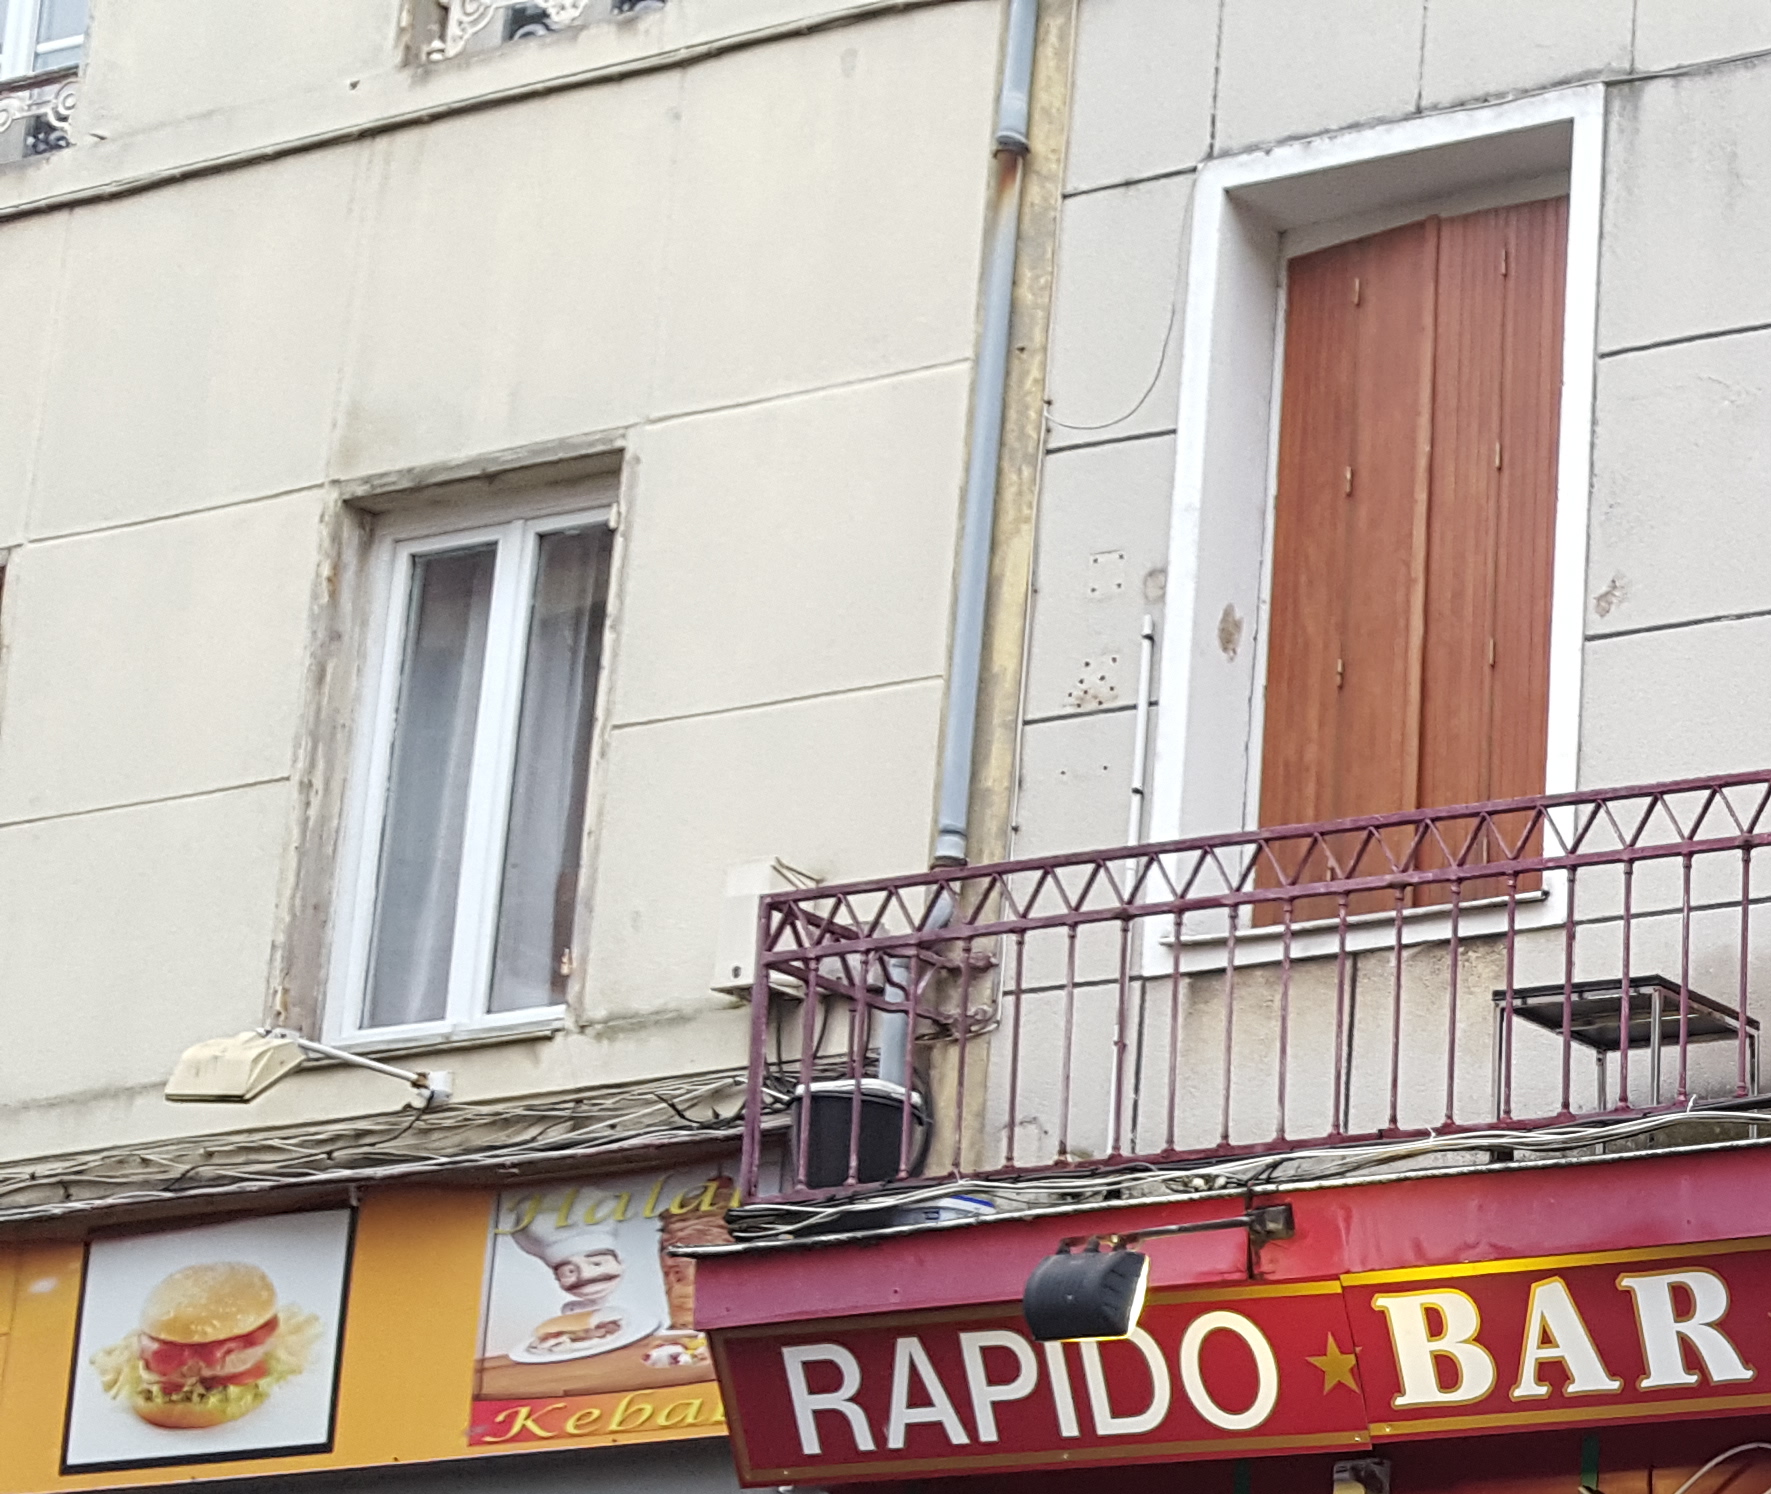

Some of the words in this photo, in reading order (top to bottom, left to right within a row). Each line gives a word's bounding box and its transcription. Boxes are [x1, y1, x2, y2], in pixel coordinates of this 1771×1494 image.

[481, 1389, 728, 1443] Keba
[781, 1308, 1279, 1456] RAPIDO
[1373, 1268, 1755, 1409] BAR
